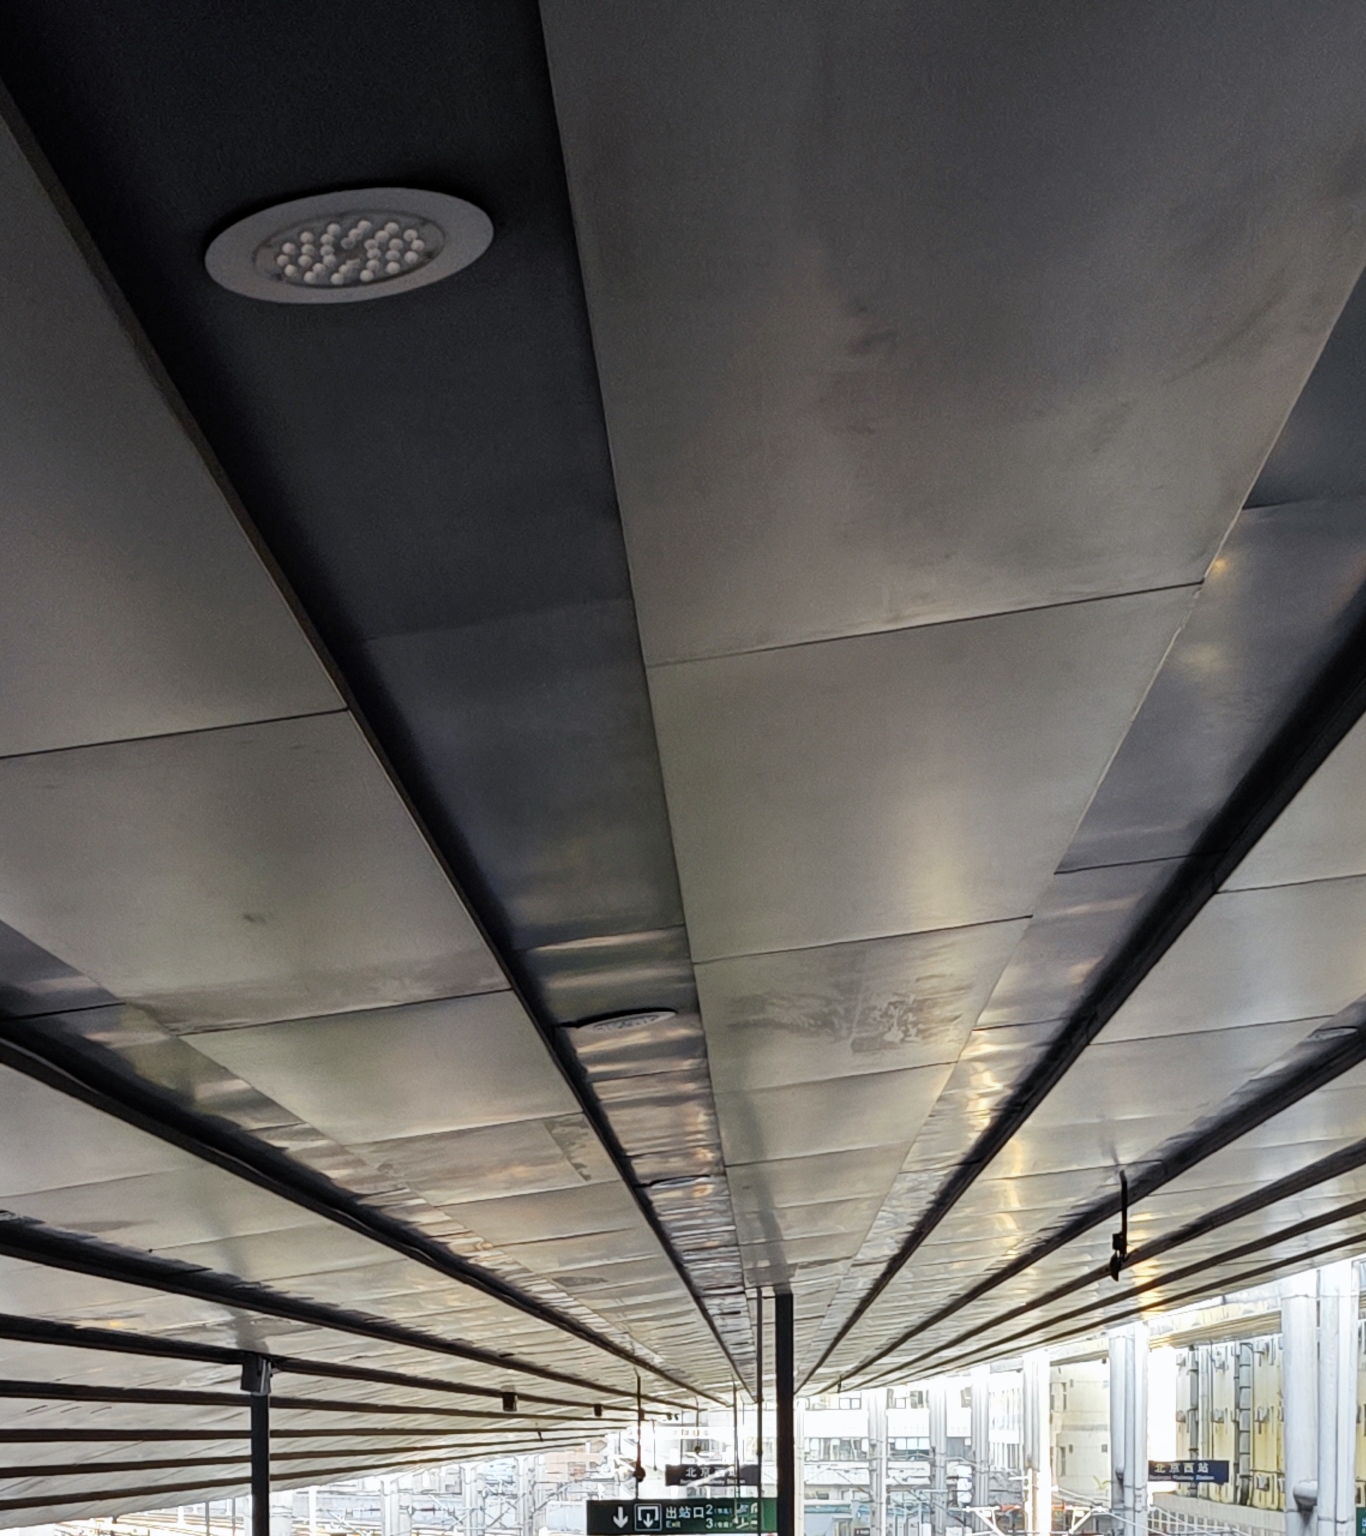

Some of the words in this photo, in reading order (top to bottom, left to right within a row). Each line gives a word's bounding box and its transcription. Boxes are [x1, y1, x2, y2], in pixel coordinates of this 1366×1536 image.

[1154, 1462, 1209, 1474] 北京西站
[665, 1506, 704, 1519] 出站口
